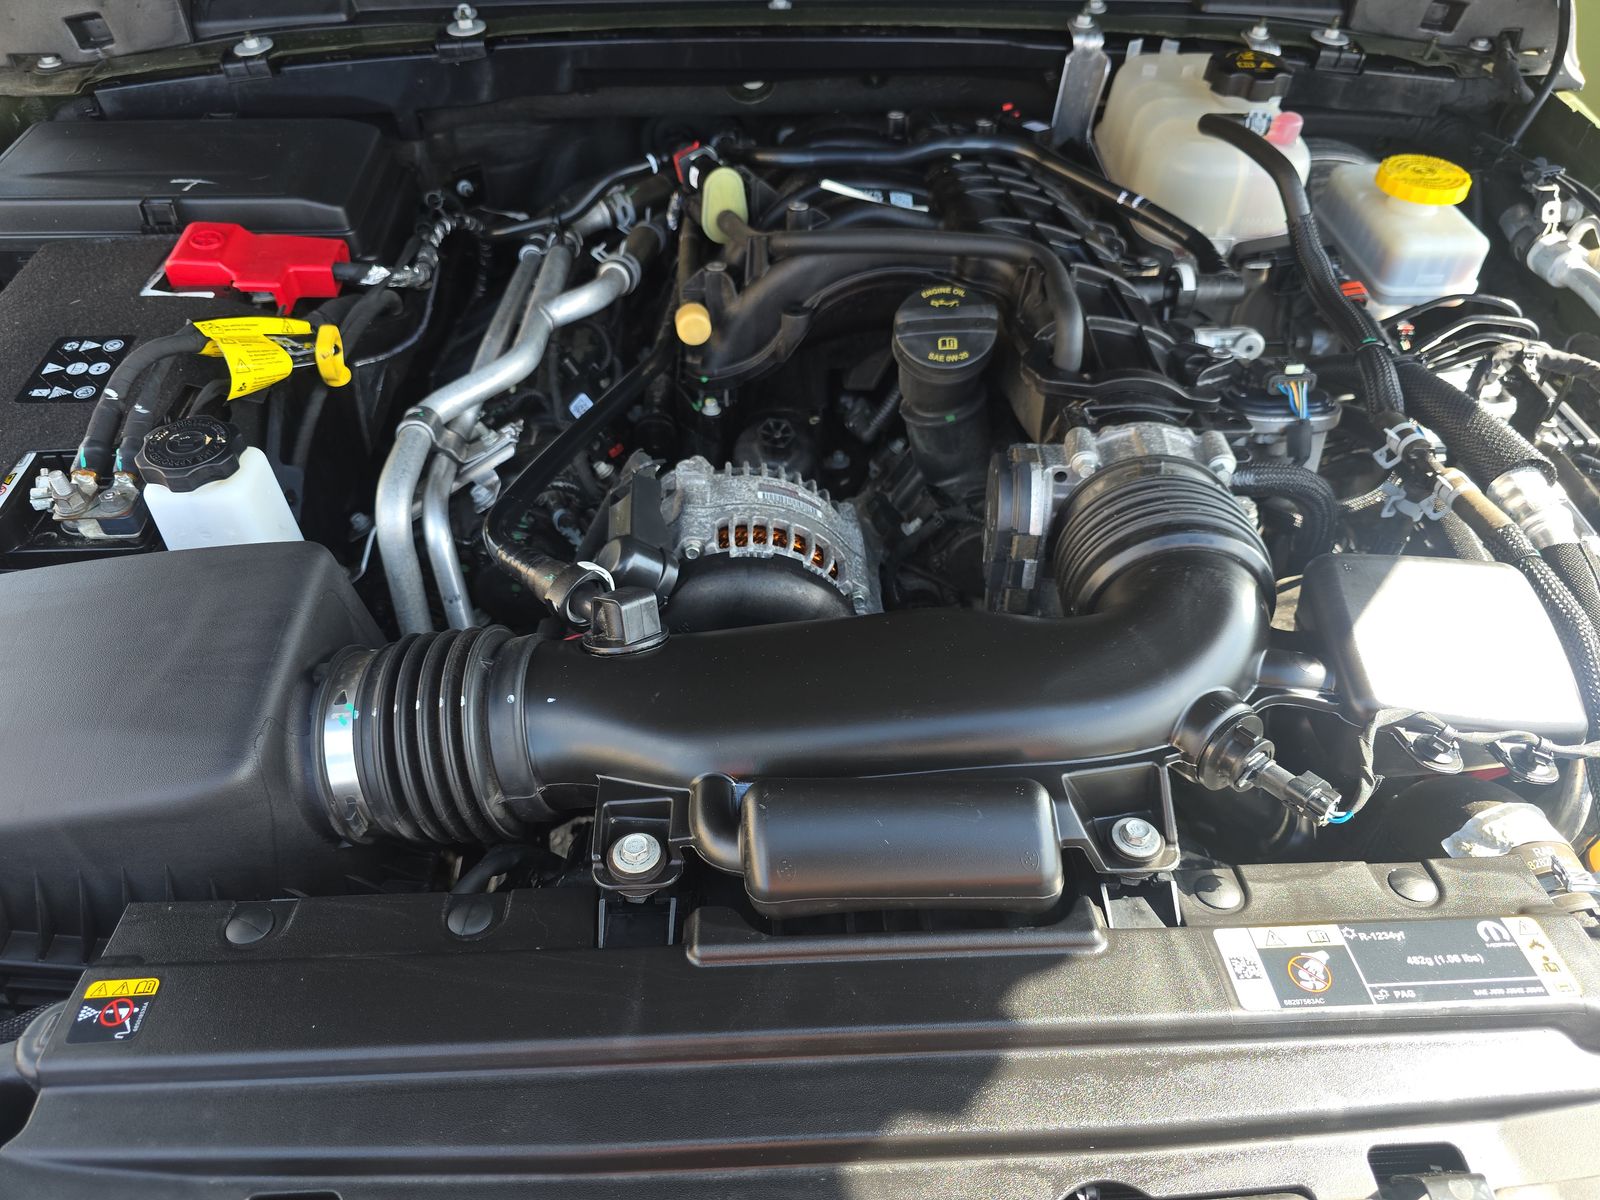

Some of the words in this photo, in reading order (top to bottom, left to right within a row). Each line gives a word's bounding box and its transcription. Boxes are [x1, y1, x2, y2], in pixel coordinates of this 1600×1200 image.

[921, 287, 952, 299] ENGINE
[953, 288, 966, 298] OIL
[928, 352, 945, 362] SAE
[946, 351, 969, 362] 0W-20
[1359, 931, 1405, 943] R-1234yf
[1393, 989, 1416, 999] PAG
